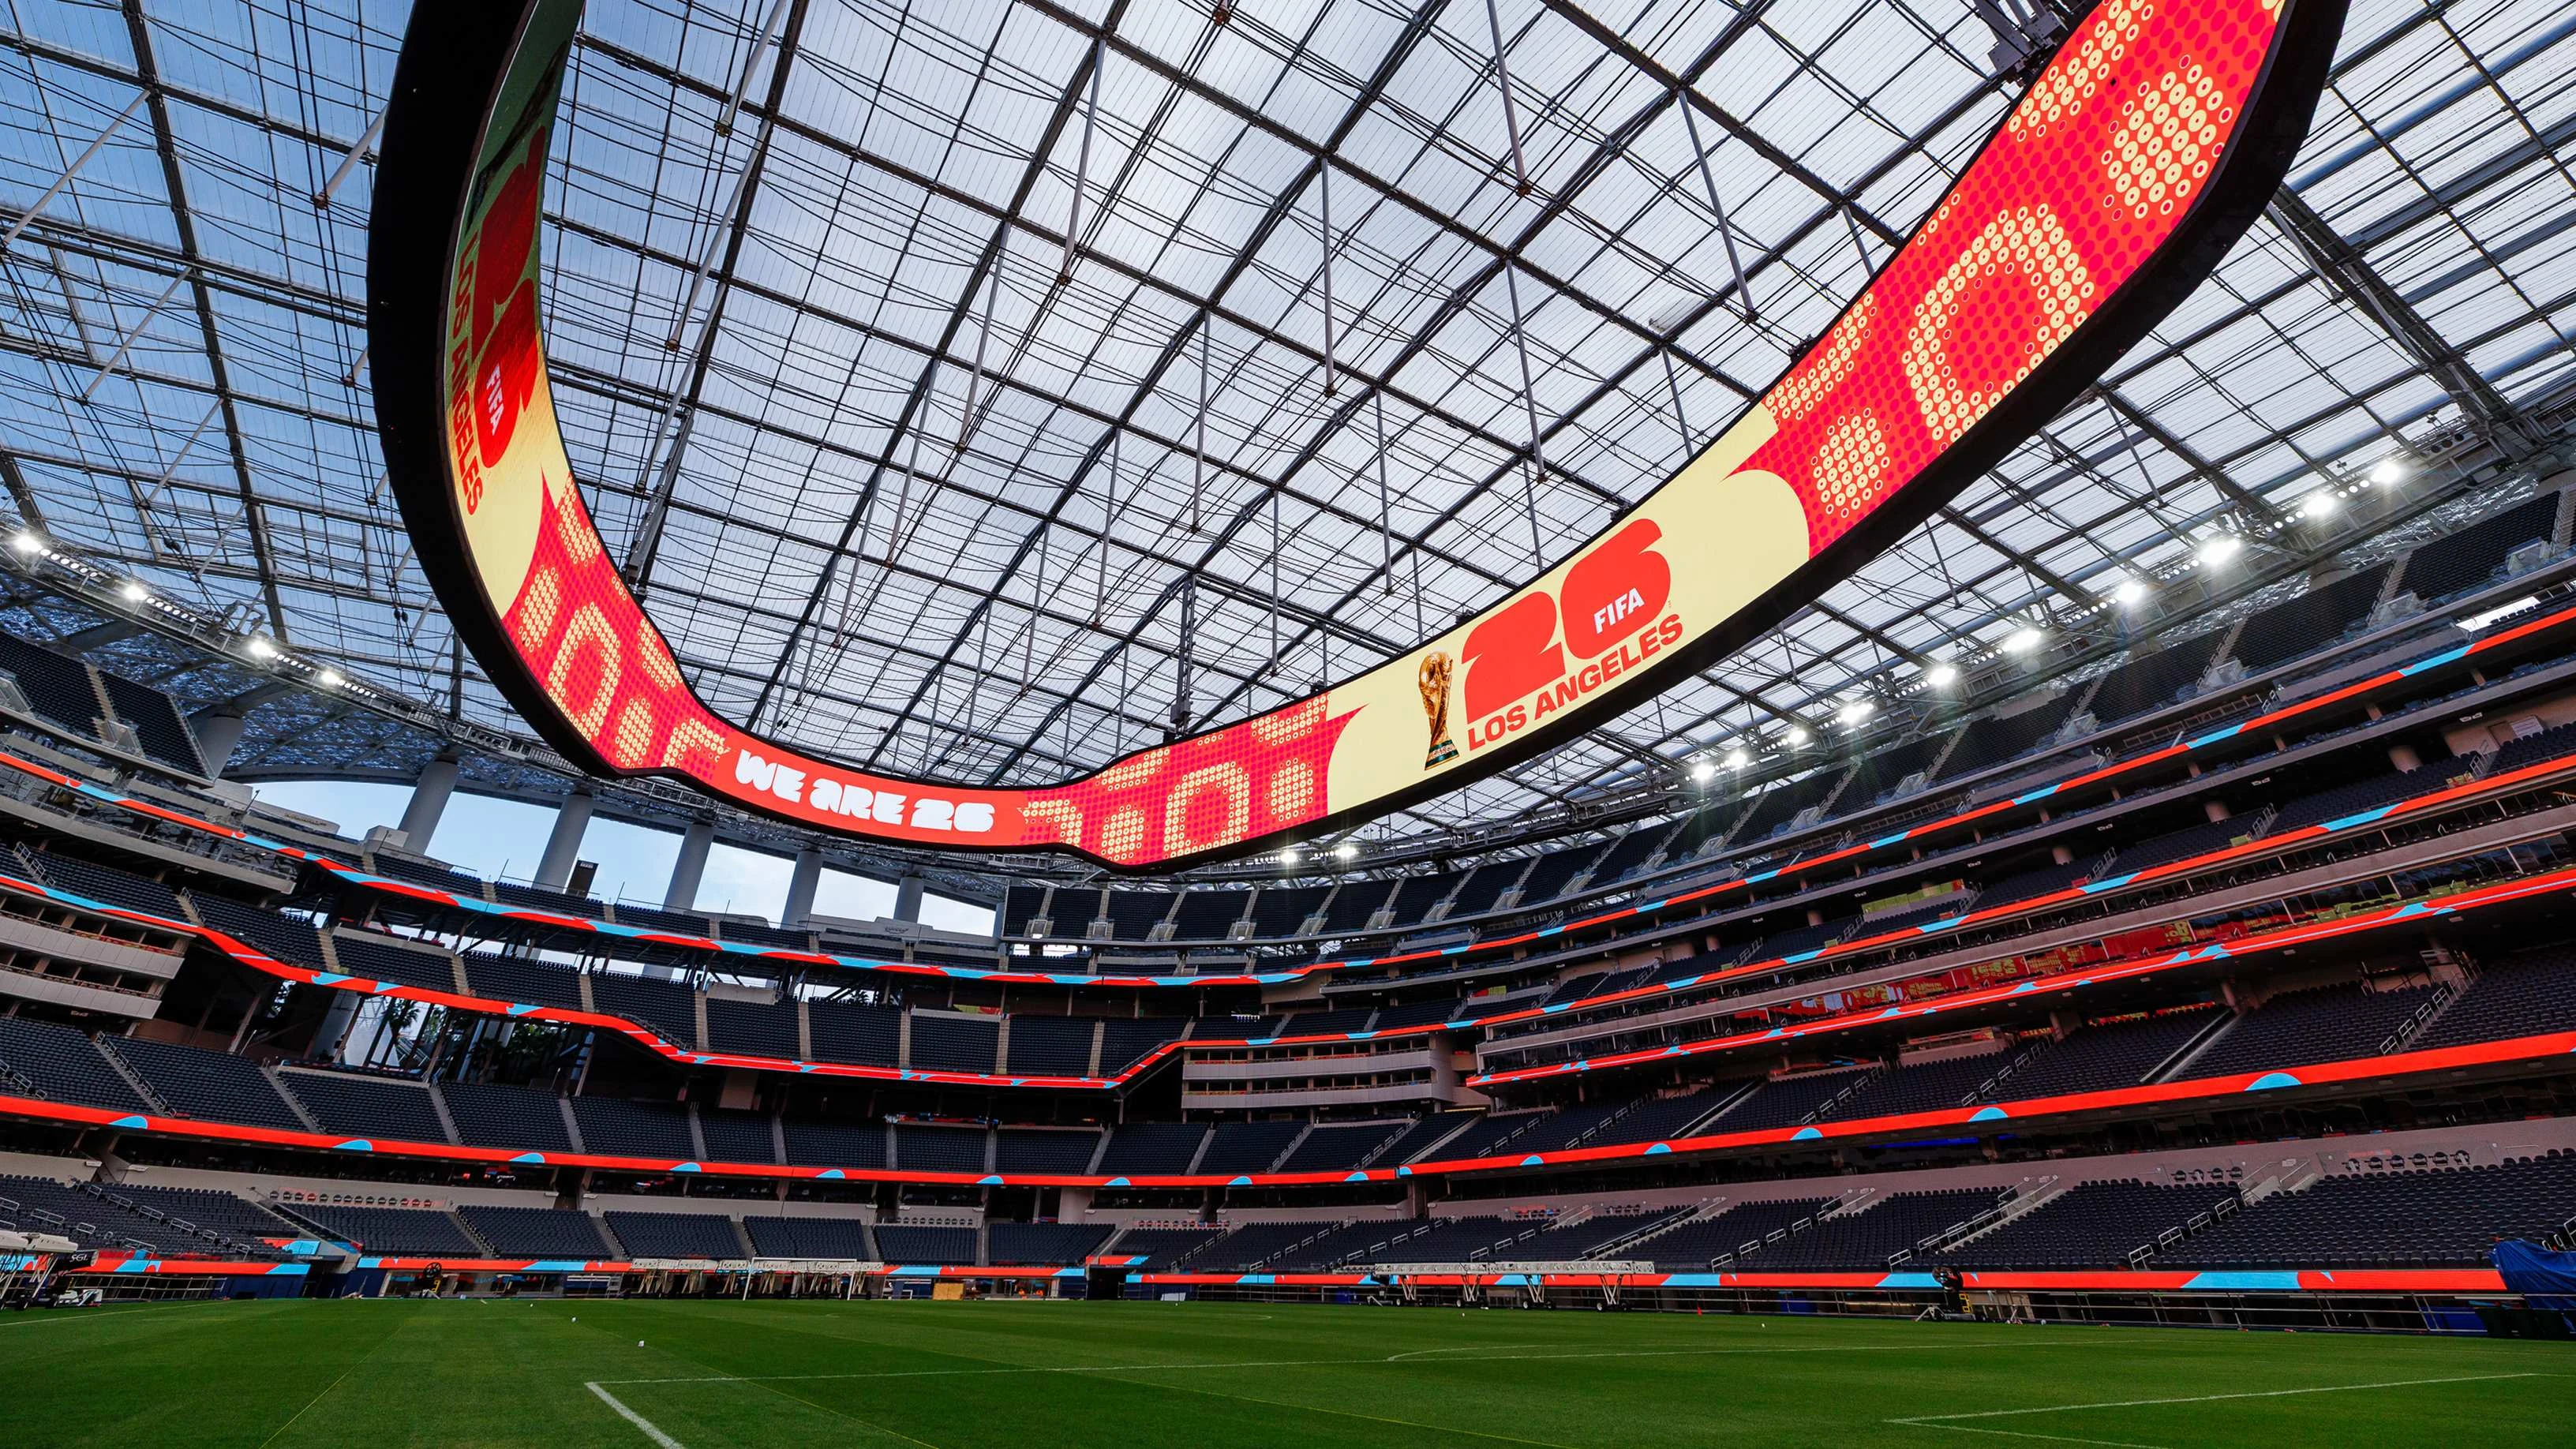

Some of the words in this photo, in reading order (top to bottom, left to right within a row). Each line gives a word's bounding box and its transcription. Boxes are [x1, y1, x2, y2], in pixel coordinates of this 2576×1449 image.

[452, 230, 479, 339] LOS
[451, 337, 483, 515] ANGELES
[486, 363, 504, 436] FIFA
[1462, 518, 1671, 725] 26
[1593, 587, 1645, 634] FIFA
[1468, 705, 1527, 751] LOS
[1534, 613, 1683, 720] ANGELES
[735, 748, 807, 803] WE
[910, 798, 995, 833] 26
[69, 1254, 88, 1263] SGL
